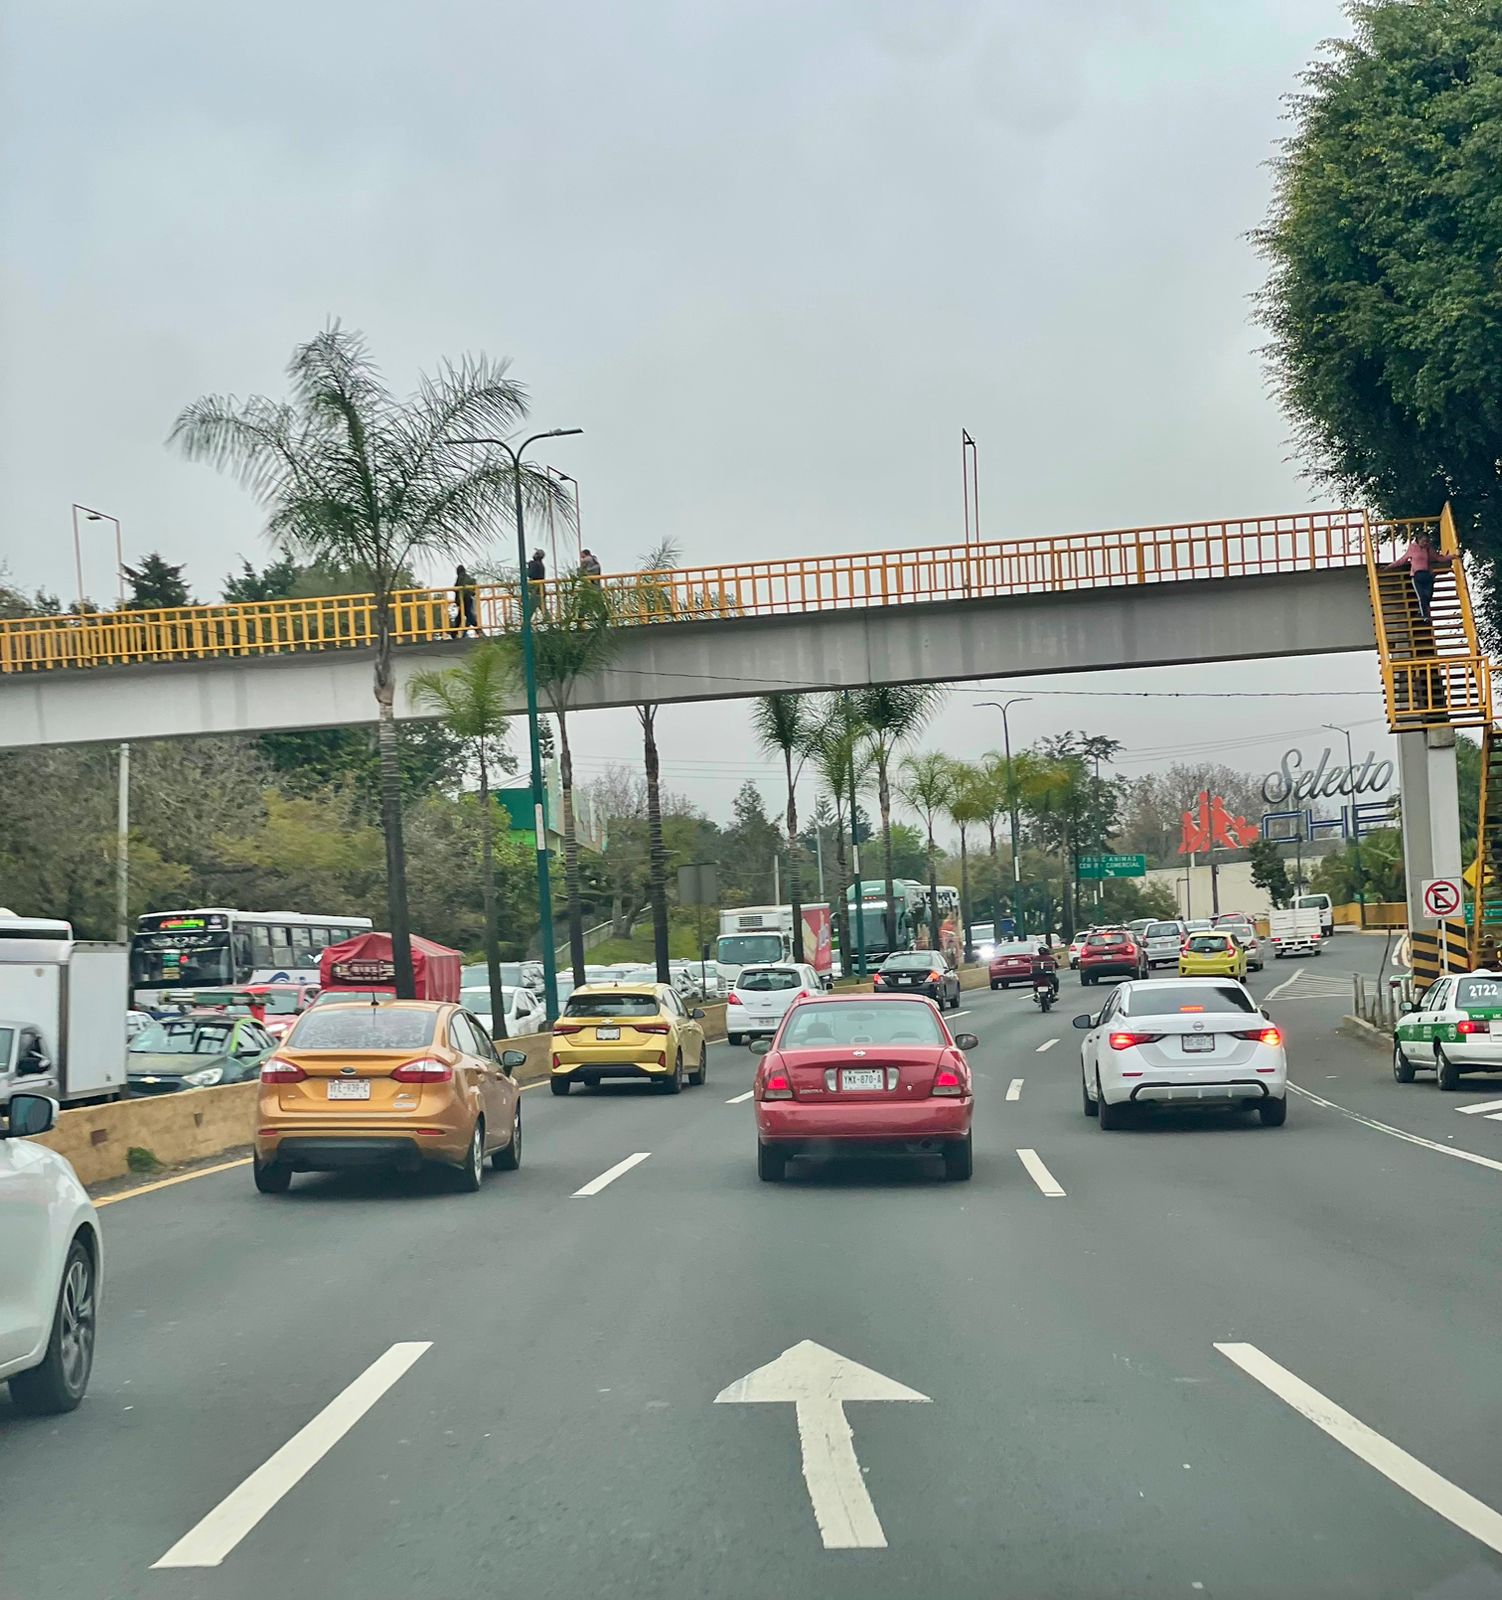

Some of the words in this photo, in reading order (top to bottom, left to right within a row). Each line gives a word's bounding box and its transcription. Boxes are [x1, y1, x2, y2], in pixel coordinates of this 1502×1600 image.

[1262, 748, 1394, 804] Selecto
[1469, 983, 1498, 996] 2722
[843, 1074, 882, 1084] YMX-870-A
